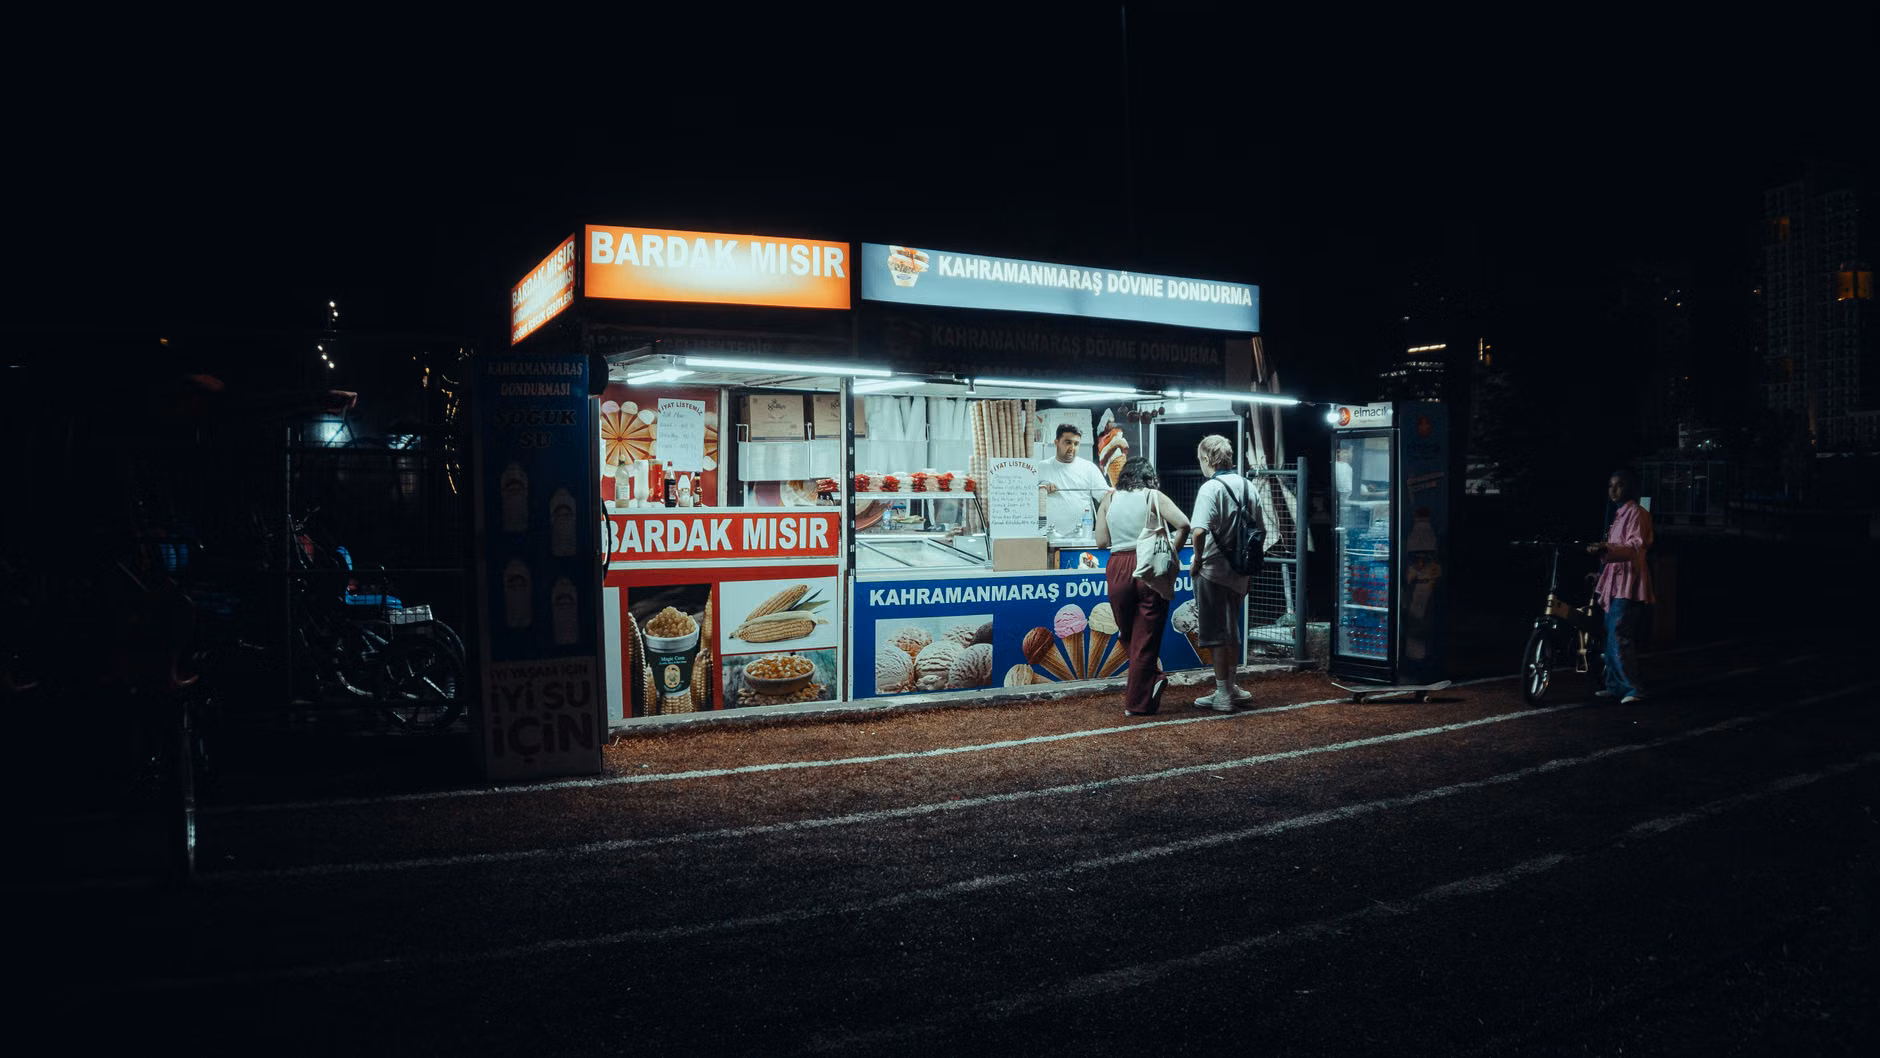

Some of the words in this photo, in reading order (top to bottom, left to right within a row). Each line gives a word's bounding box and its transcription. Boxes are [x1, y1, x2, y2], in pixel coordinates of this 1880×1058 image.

[546, 241, 574, 281] MISIR
[591, 231, 739, 270] BARDAK
[750, 241, 846, 278] MISIR
[938, 255, 1103, 296] KAHRAMANMARAŞ
[1107, 270, 1163, 298] DÖVME
[1167, 283, 1253, 307] DONDURMA
[931, 325, 1081, 359] KAHRAMANMARAŞ
[1140, 340, 1219, 366] DONDURMA
[487, 362, 584, 378] KAHRAMANMARAŞ
[500, 383, 571, 396] DONDURMASI
[602, 518, 732, 553] BARDAK
[743, 517, 829, 552] MISIR
[869, 583, 1060, 607] KAHRAMANMARAŞ
[1065, 578, 1109, 598] DÖV
[543, 681, 591, 710] SU
